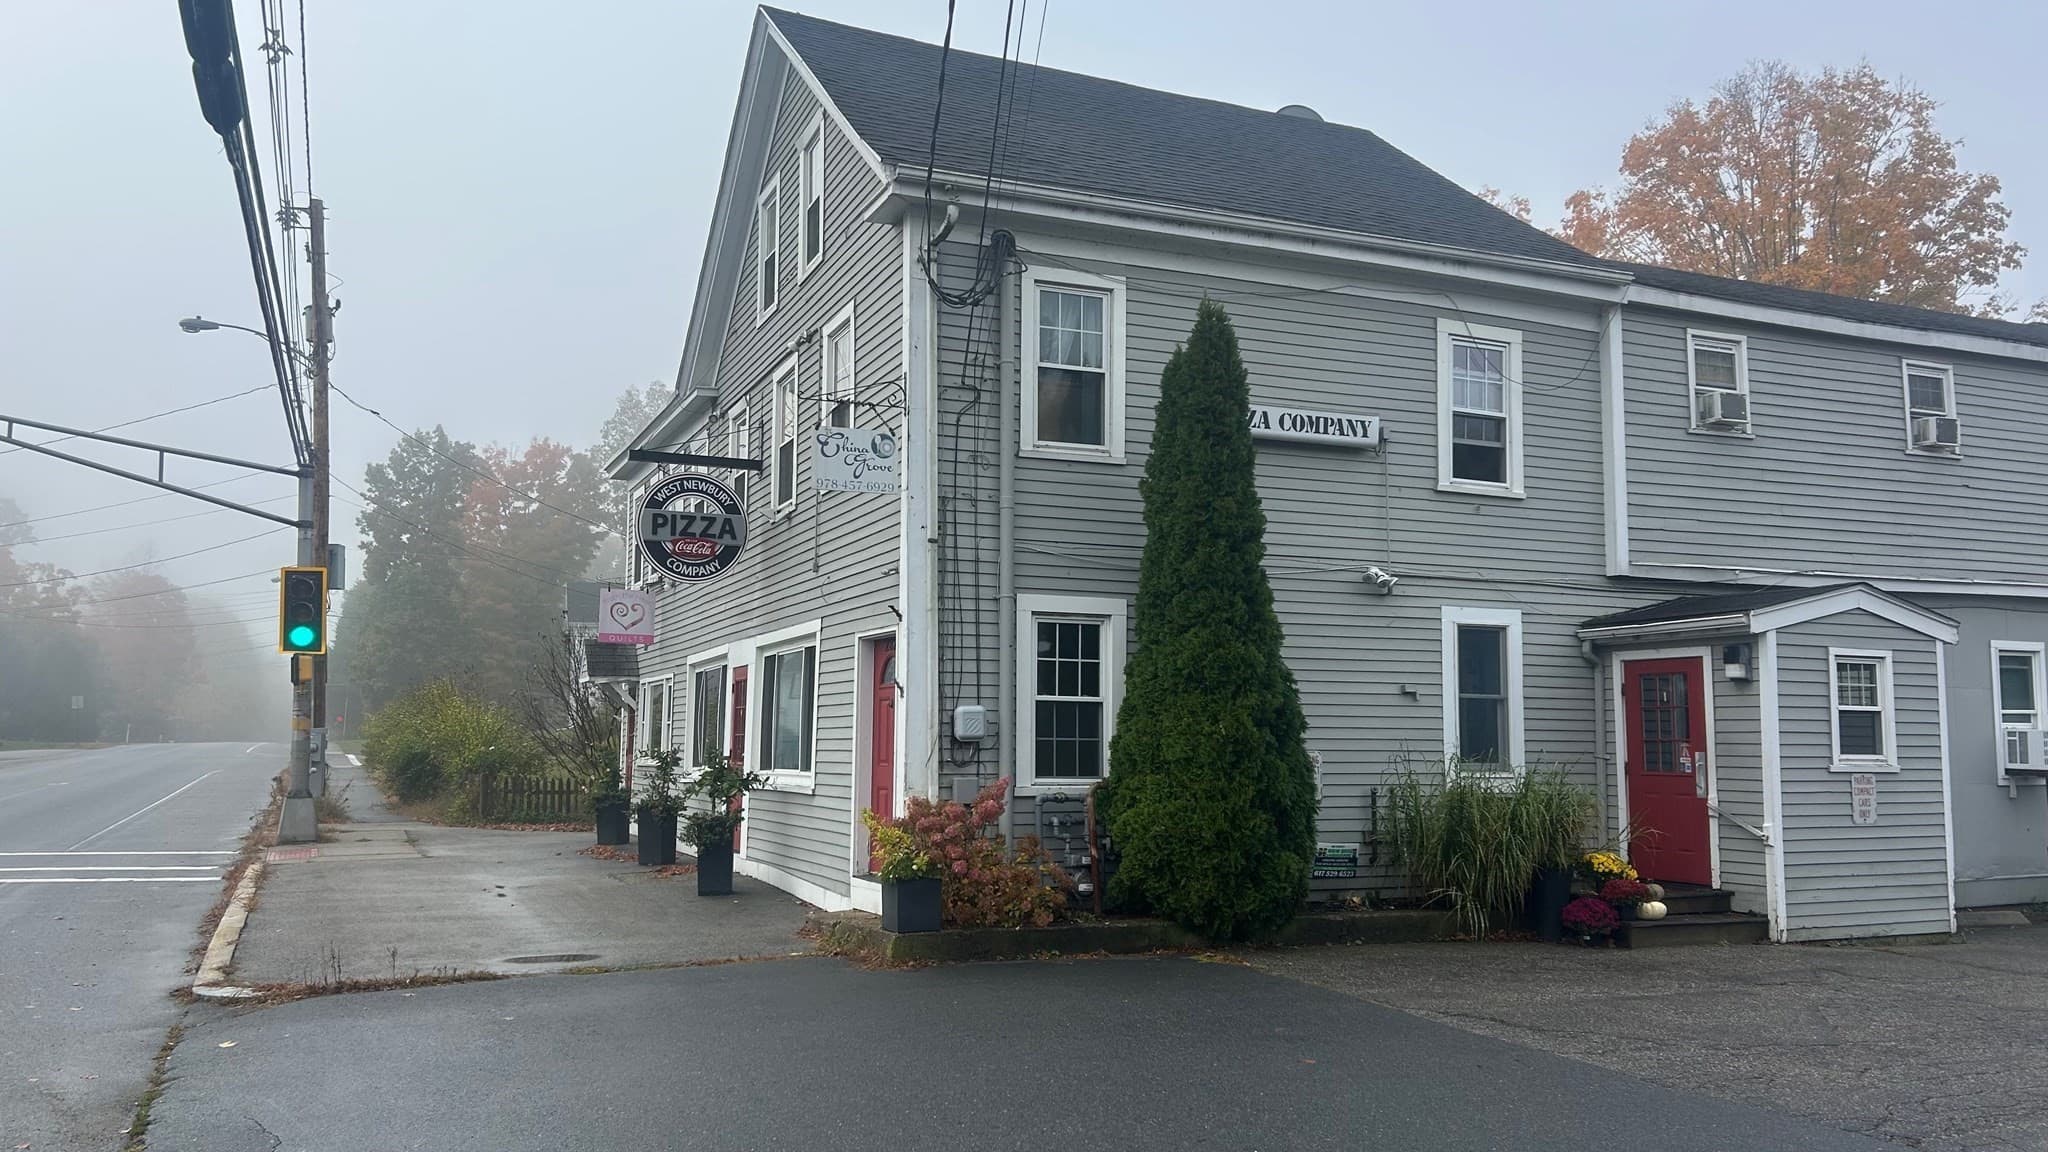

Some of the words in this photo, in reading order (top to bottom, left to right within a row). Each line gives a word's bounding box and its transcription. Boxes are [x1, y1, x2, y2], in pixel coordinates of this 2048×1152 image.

[1279, 412, 1372, 438] COMPANY
[817, 432, 870, 458] China
[844, 453, 893, 479] Grove
[654, 482, 682, 502] WEST
[683, 480, 734, 506] NEWBURY
[651, 513, 737, 540] PIZZA
[666, 558, 721, 576] COMPANY
[609, 635, 645, 643] QUILTS
[1854, 787, 1874, 796] COMPACT
[1859, 798, 1871, 807] CARS
[1859, 809, 1871, 818] ONLY
